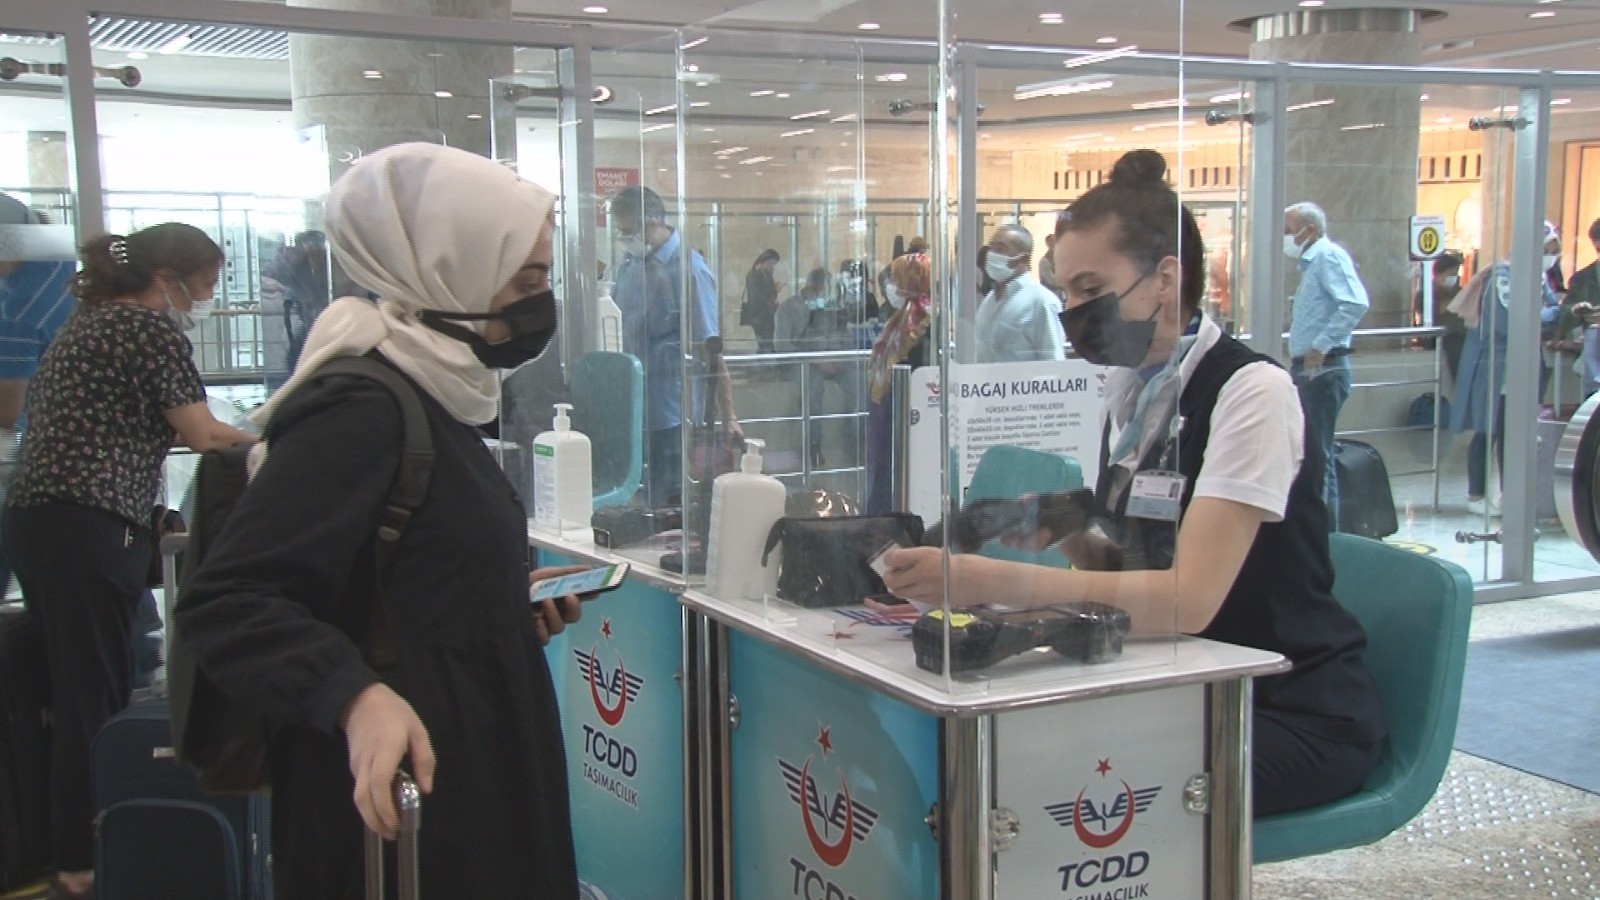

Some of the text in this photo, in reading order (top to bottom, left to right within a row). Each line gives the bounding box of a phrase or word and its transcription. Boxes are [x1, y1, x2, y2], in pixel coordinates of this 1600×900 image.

[961, 382, 1006, 399] BAGAJ
[1011, 378, 1088, 396] KURALLARI
[583, 724, 637, 778] TCDD
[583, 762, 637, 807] TAŞIMACILIK
[1058, 850, 1149, 892] TCDD
